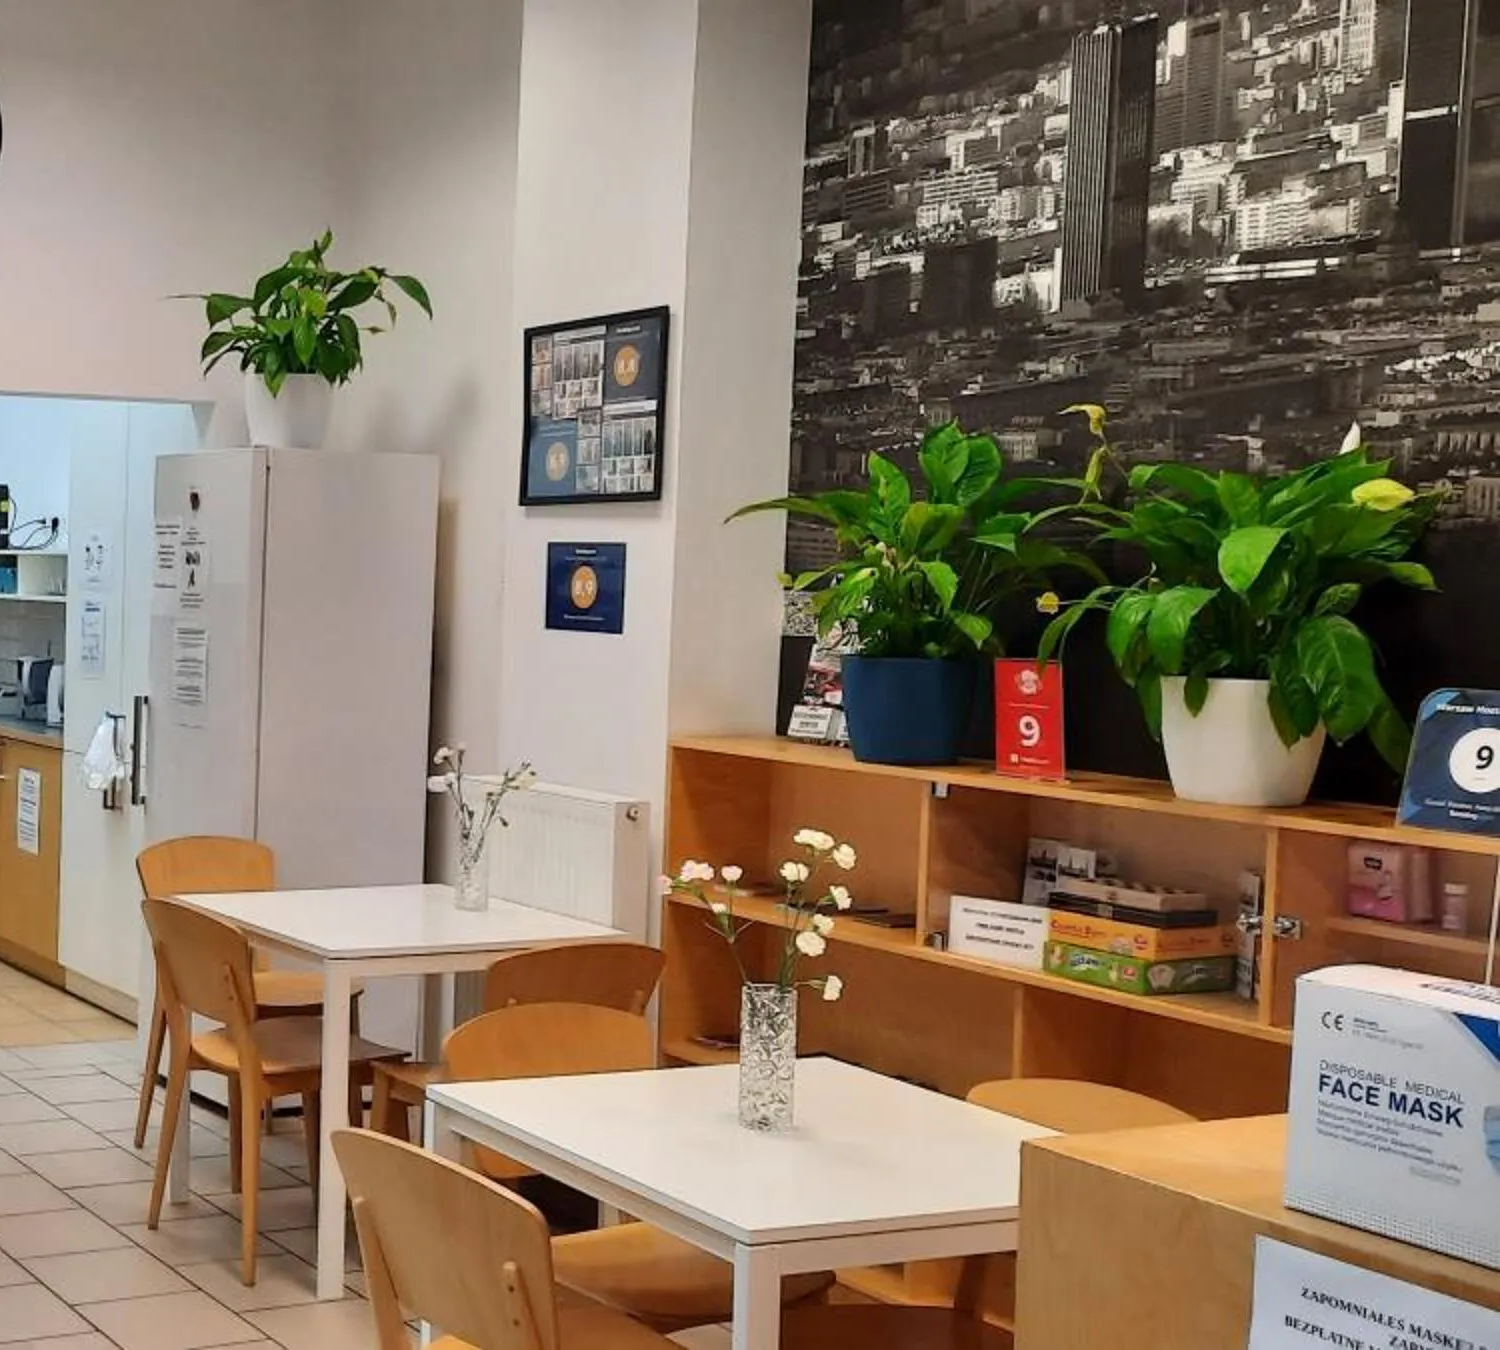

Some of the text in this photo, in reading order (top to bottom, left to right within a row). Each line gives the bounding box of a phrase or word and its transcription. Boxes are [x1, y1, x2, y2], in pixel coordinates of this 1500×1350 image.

[1018, 714, 1041, 748] 9
[1475, 745, 1495, 770] 9
[1318, 1073, 1381, 1107] FACE
[1387, 1091, 1464, 1129] MASK
[1319, 1059, 1464, 1105] DISPOSABLE MEDICAL
